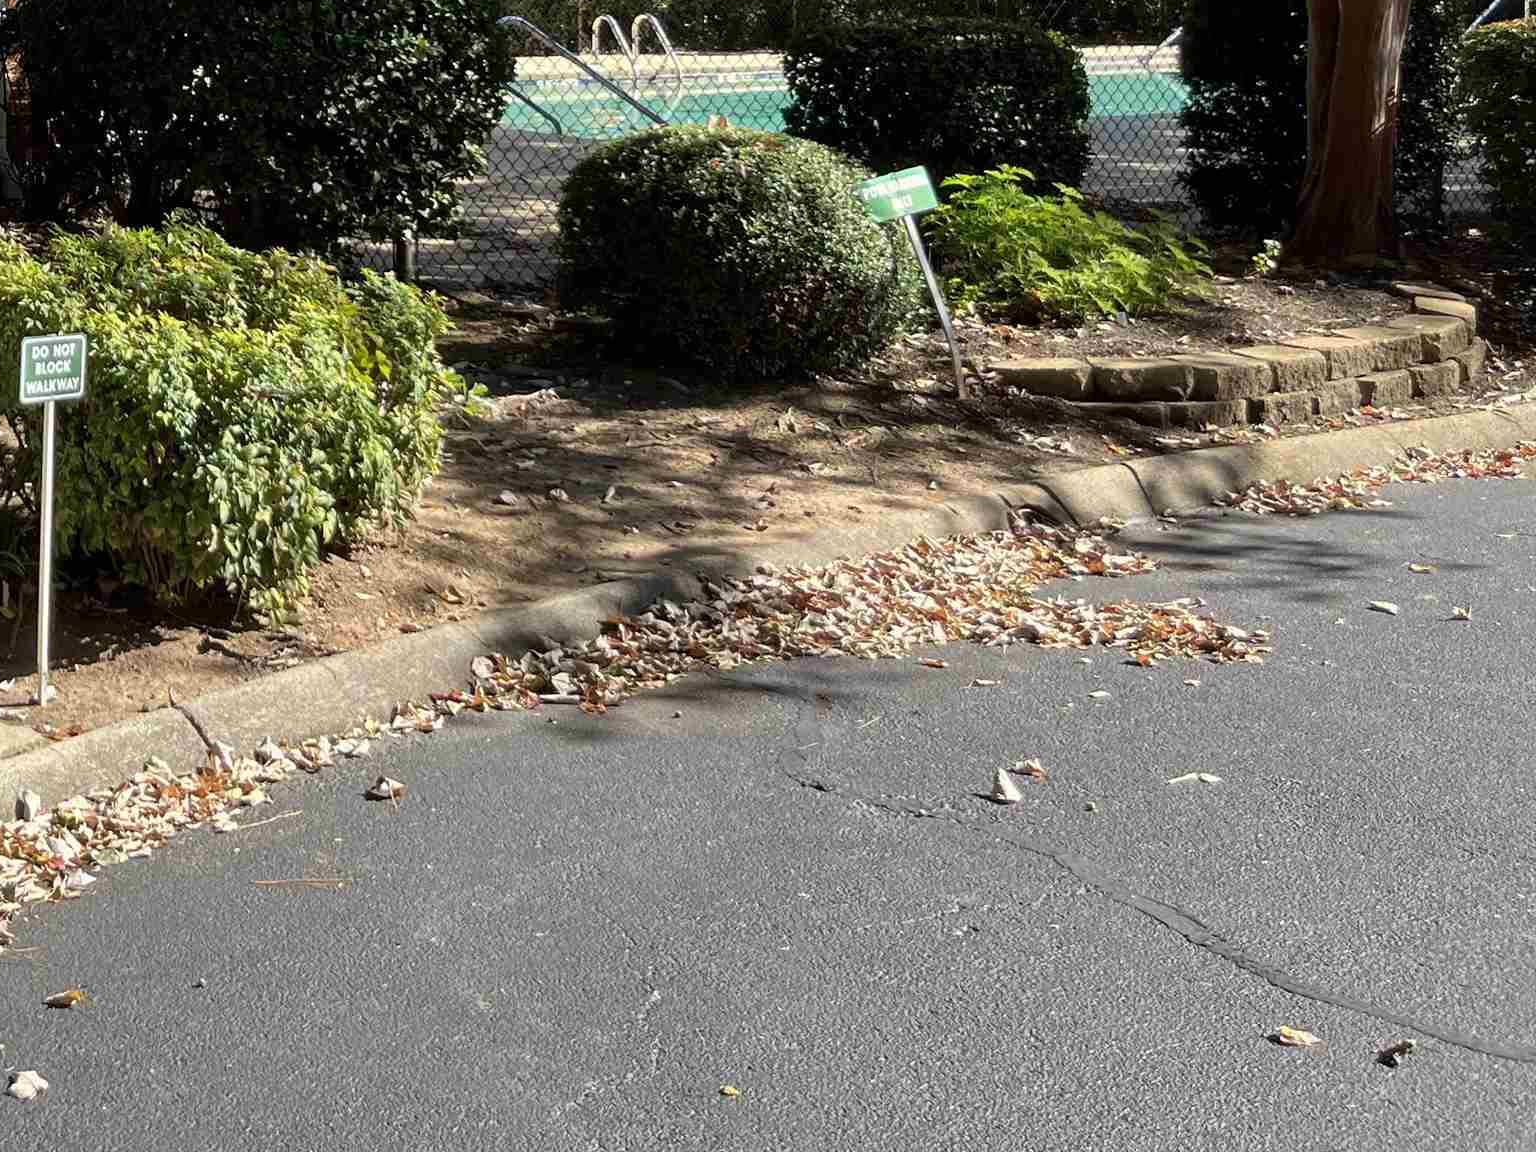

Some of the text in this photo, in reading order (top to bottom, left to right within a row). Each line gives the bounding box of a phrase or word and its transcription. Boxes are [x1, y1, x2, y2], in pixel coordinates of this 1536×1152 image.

[32, 342, 76, 360] DO NOT
[34, 359, 72, 376] BLOCK
[26, 377, 80, 395] WALKWAY
